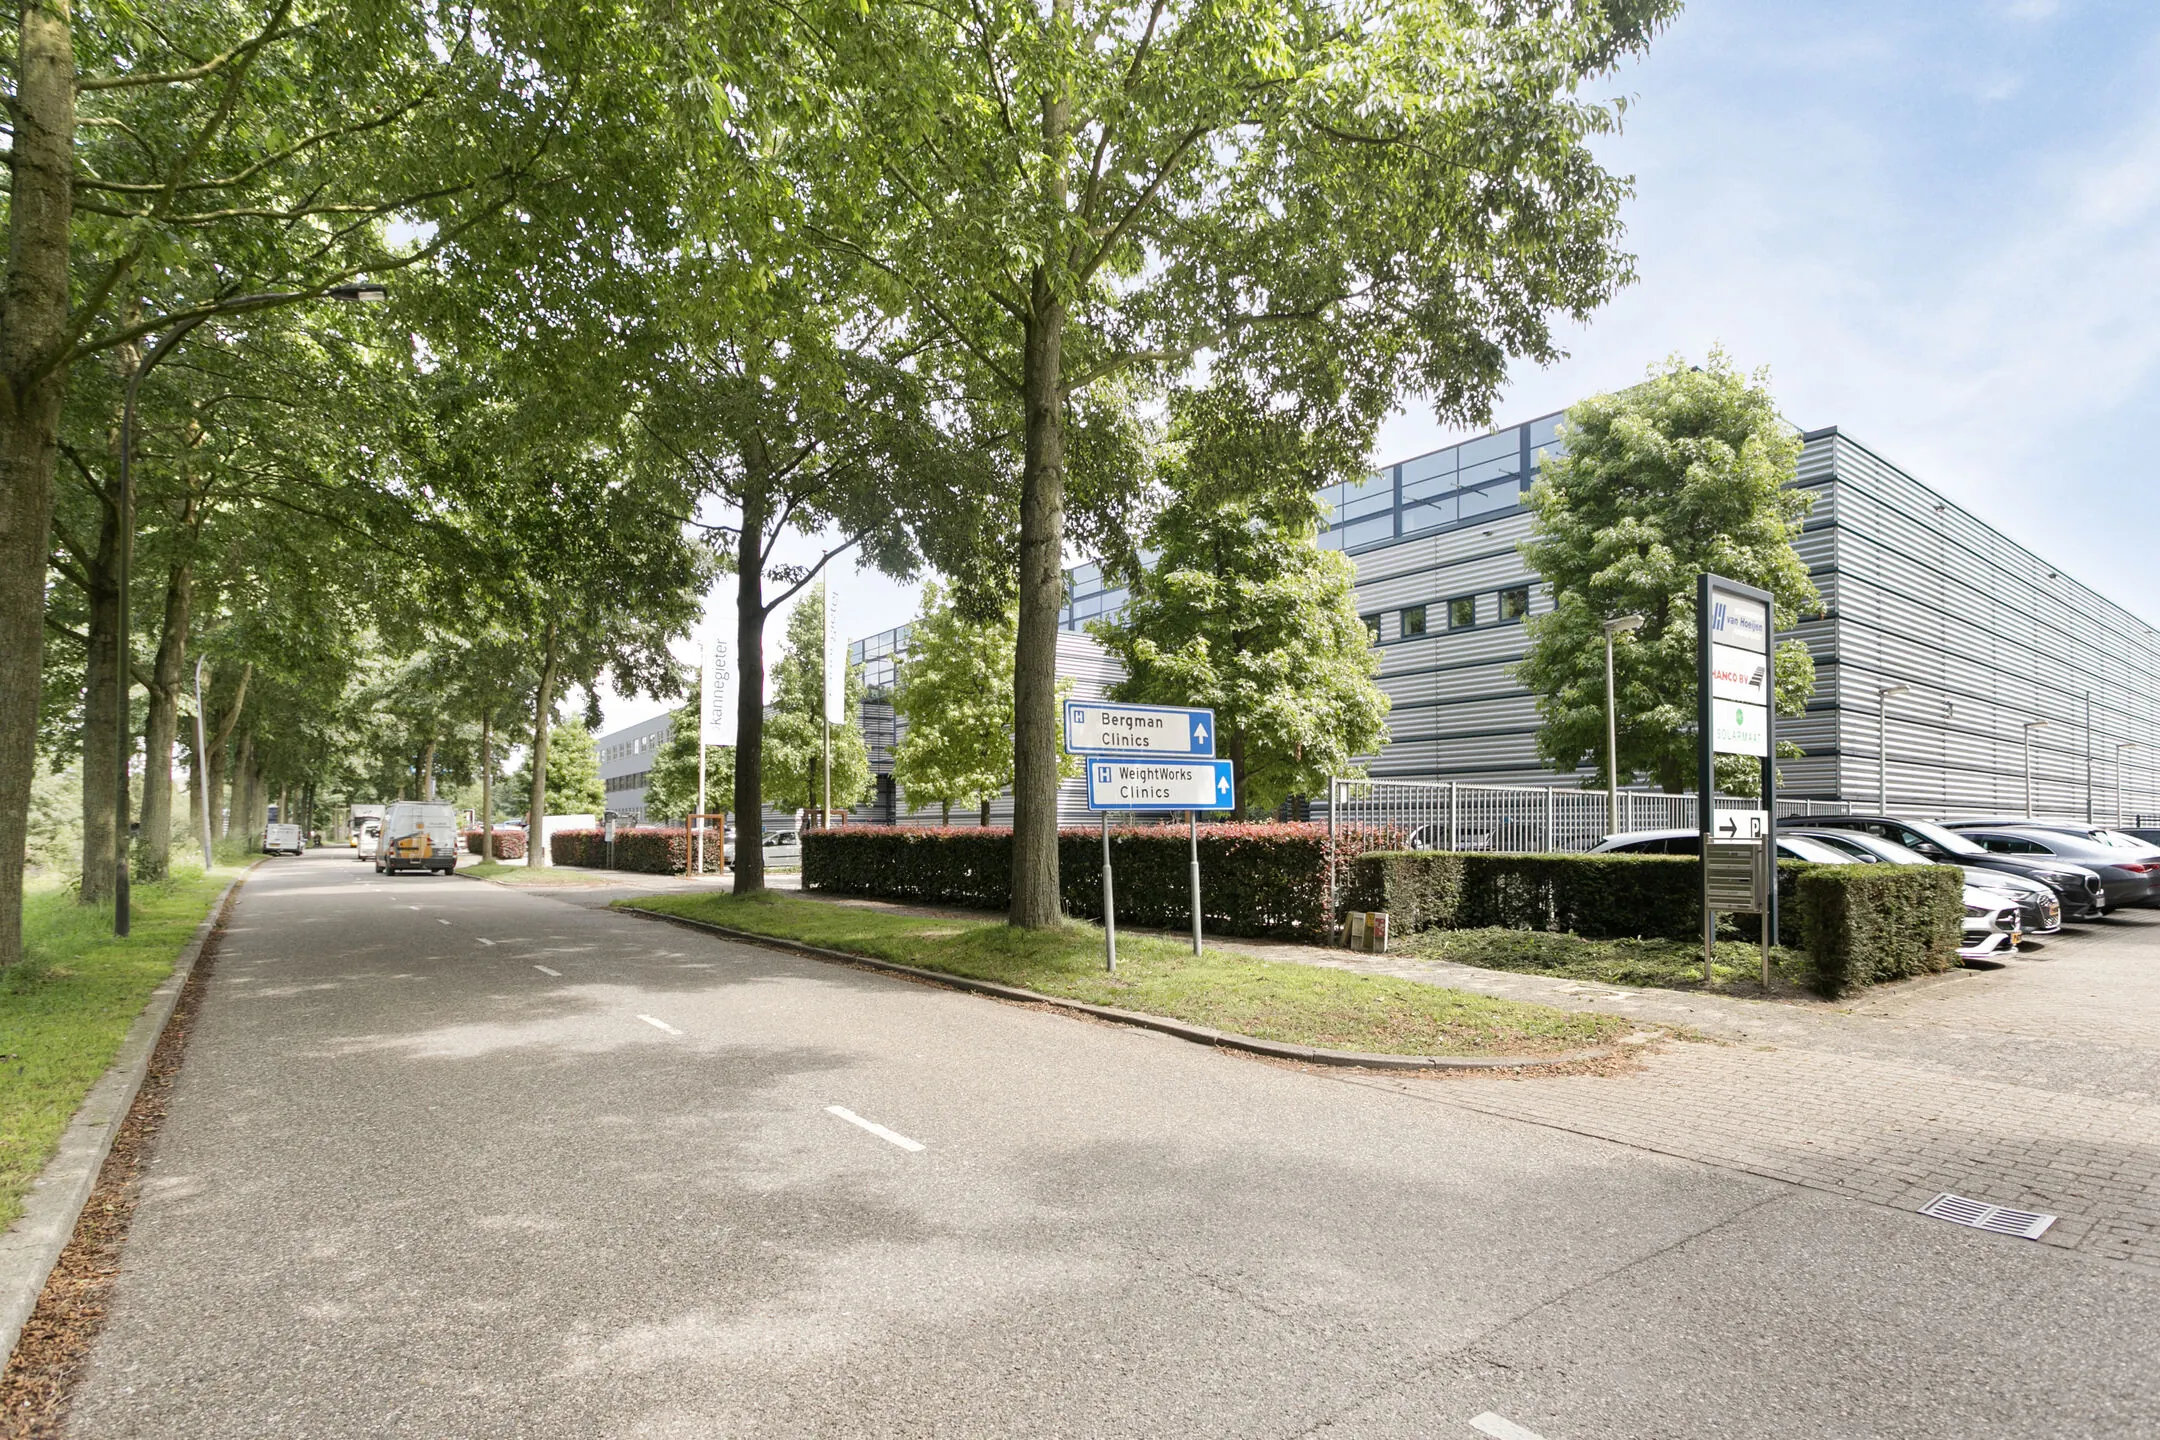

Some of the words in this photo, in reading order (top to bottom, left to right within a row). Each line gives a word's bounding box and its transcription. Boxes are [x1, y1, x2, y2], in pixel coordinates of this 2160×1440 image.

[1727, 616, 1738, 626] van
[1074, 711, 1084, 723] H
[1102, 712, 1163, 729] Bergman
[1102, 732, 1149, 747] Clinics
[1099, 767, 1111, 783] H
[1119, 767, 1192, 783] WeightWorks
[1120, 786, 1170, 798] Clinics
[1751, 817, 1760, 837] P
